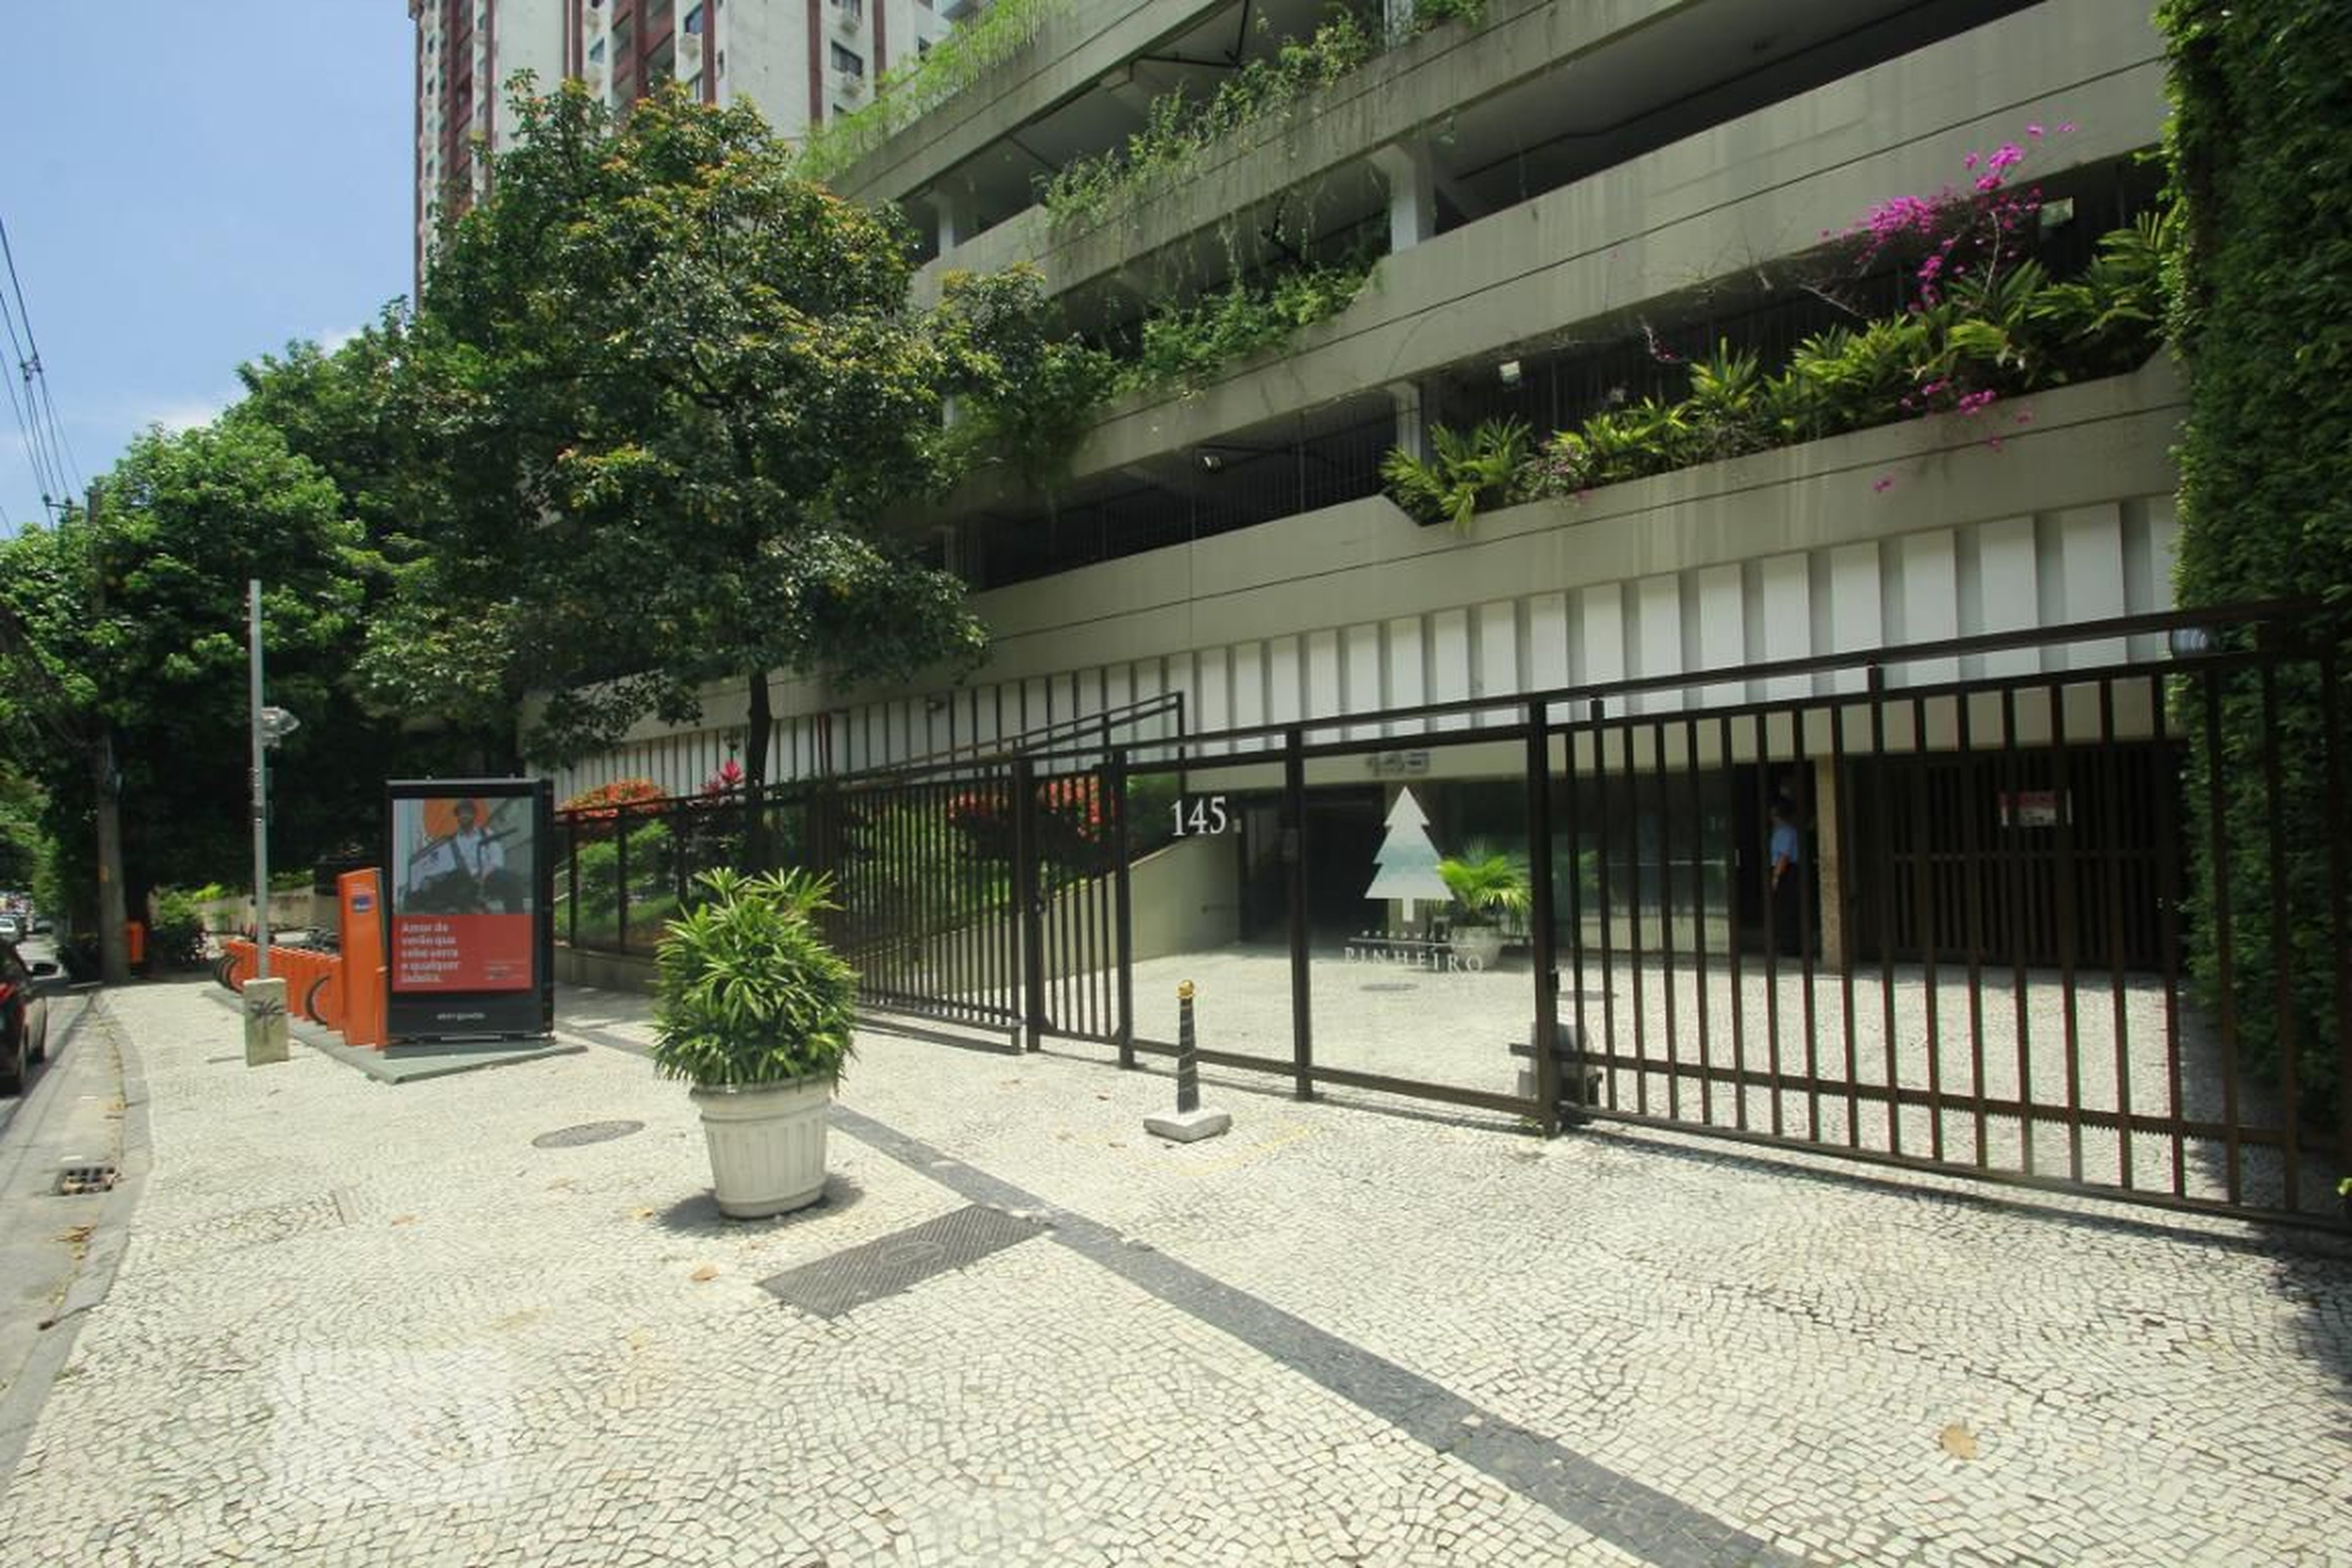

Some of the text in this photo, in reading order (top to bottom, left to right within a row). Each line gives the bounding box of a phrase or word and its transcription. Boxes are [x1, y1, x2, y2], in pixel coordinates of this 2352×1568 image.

[1169, 796, 1226, 837] 145
[402, 922, 431, 932] Amor
[1344, 946, 1483, 974] PINHEIRO
